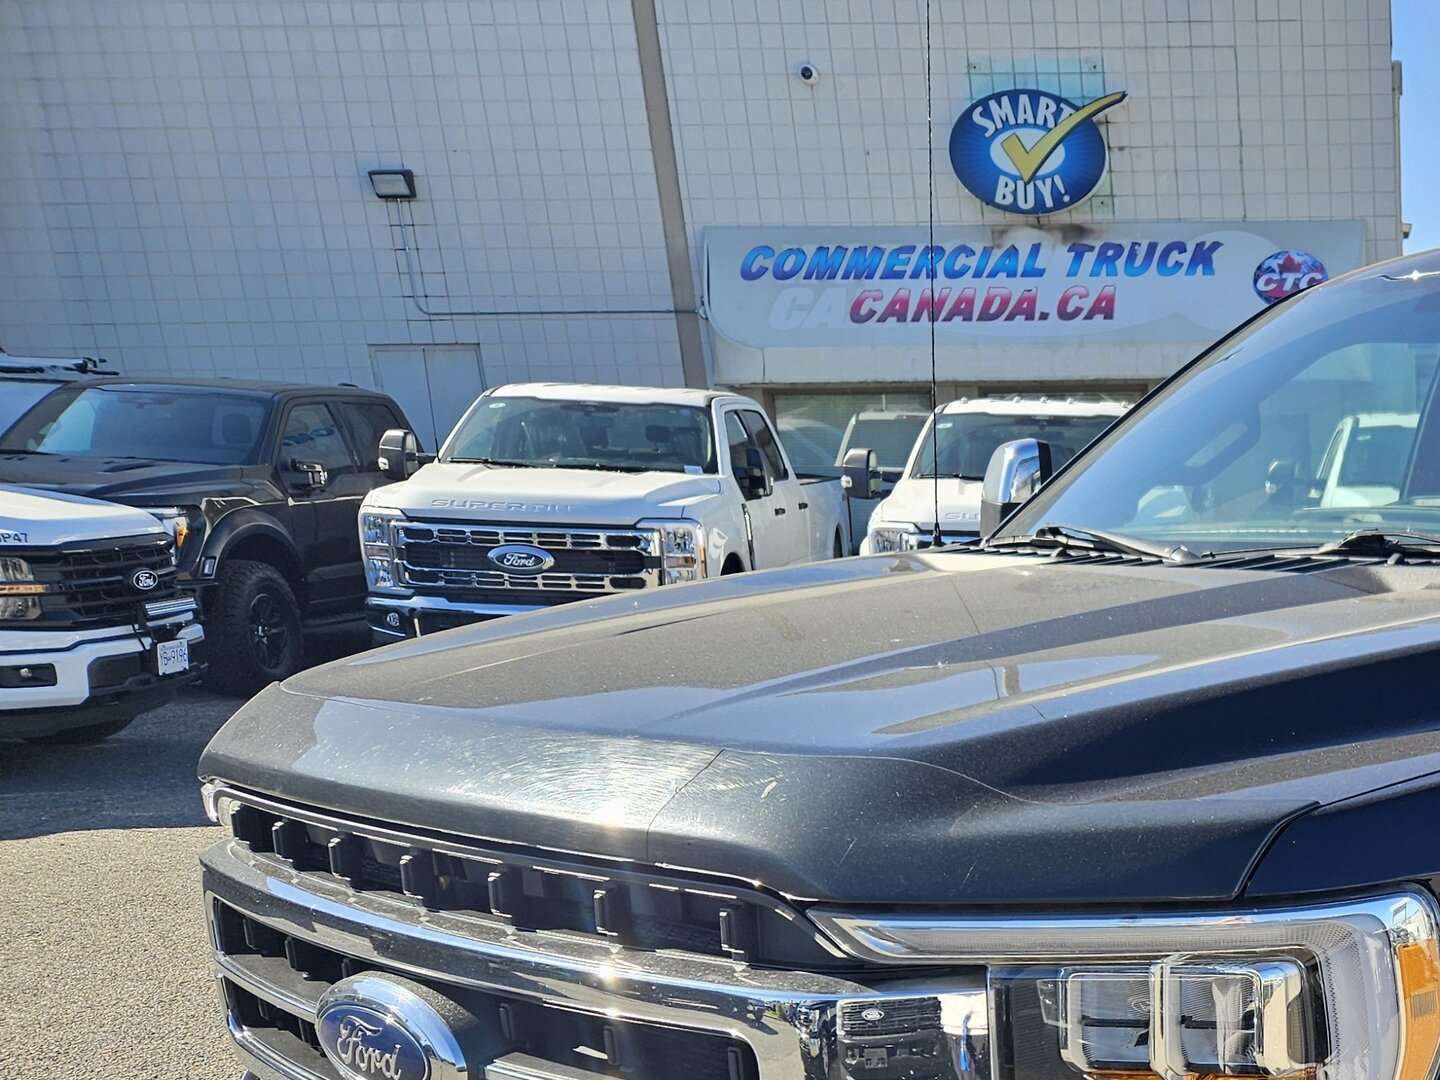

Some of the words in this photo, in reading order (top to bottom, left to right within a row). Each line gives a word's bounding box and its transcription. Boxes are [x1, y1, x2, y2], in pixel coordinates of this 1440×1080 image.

[972, 94, 1077, 138] SMART
[995, 175, 1071, 210] BUY!
[740, 244, 1046, 282] COMMERCIAL
[1065, 240, 1225, 278] TRUCK
[1256, 272, 1323, 291] CTC
[848, 285, 1118, 324] CANADA.CA
[503, 552, 536, 567] Ford
[336, 1014, 402, 1080] Ford
